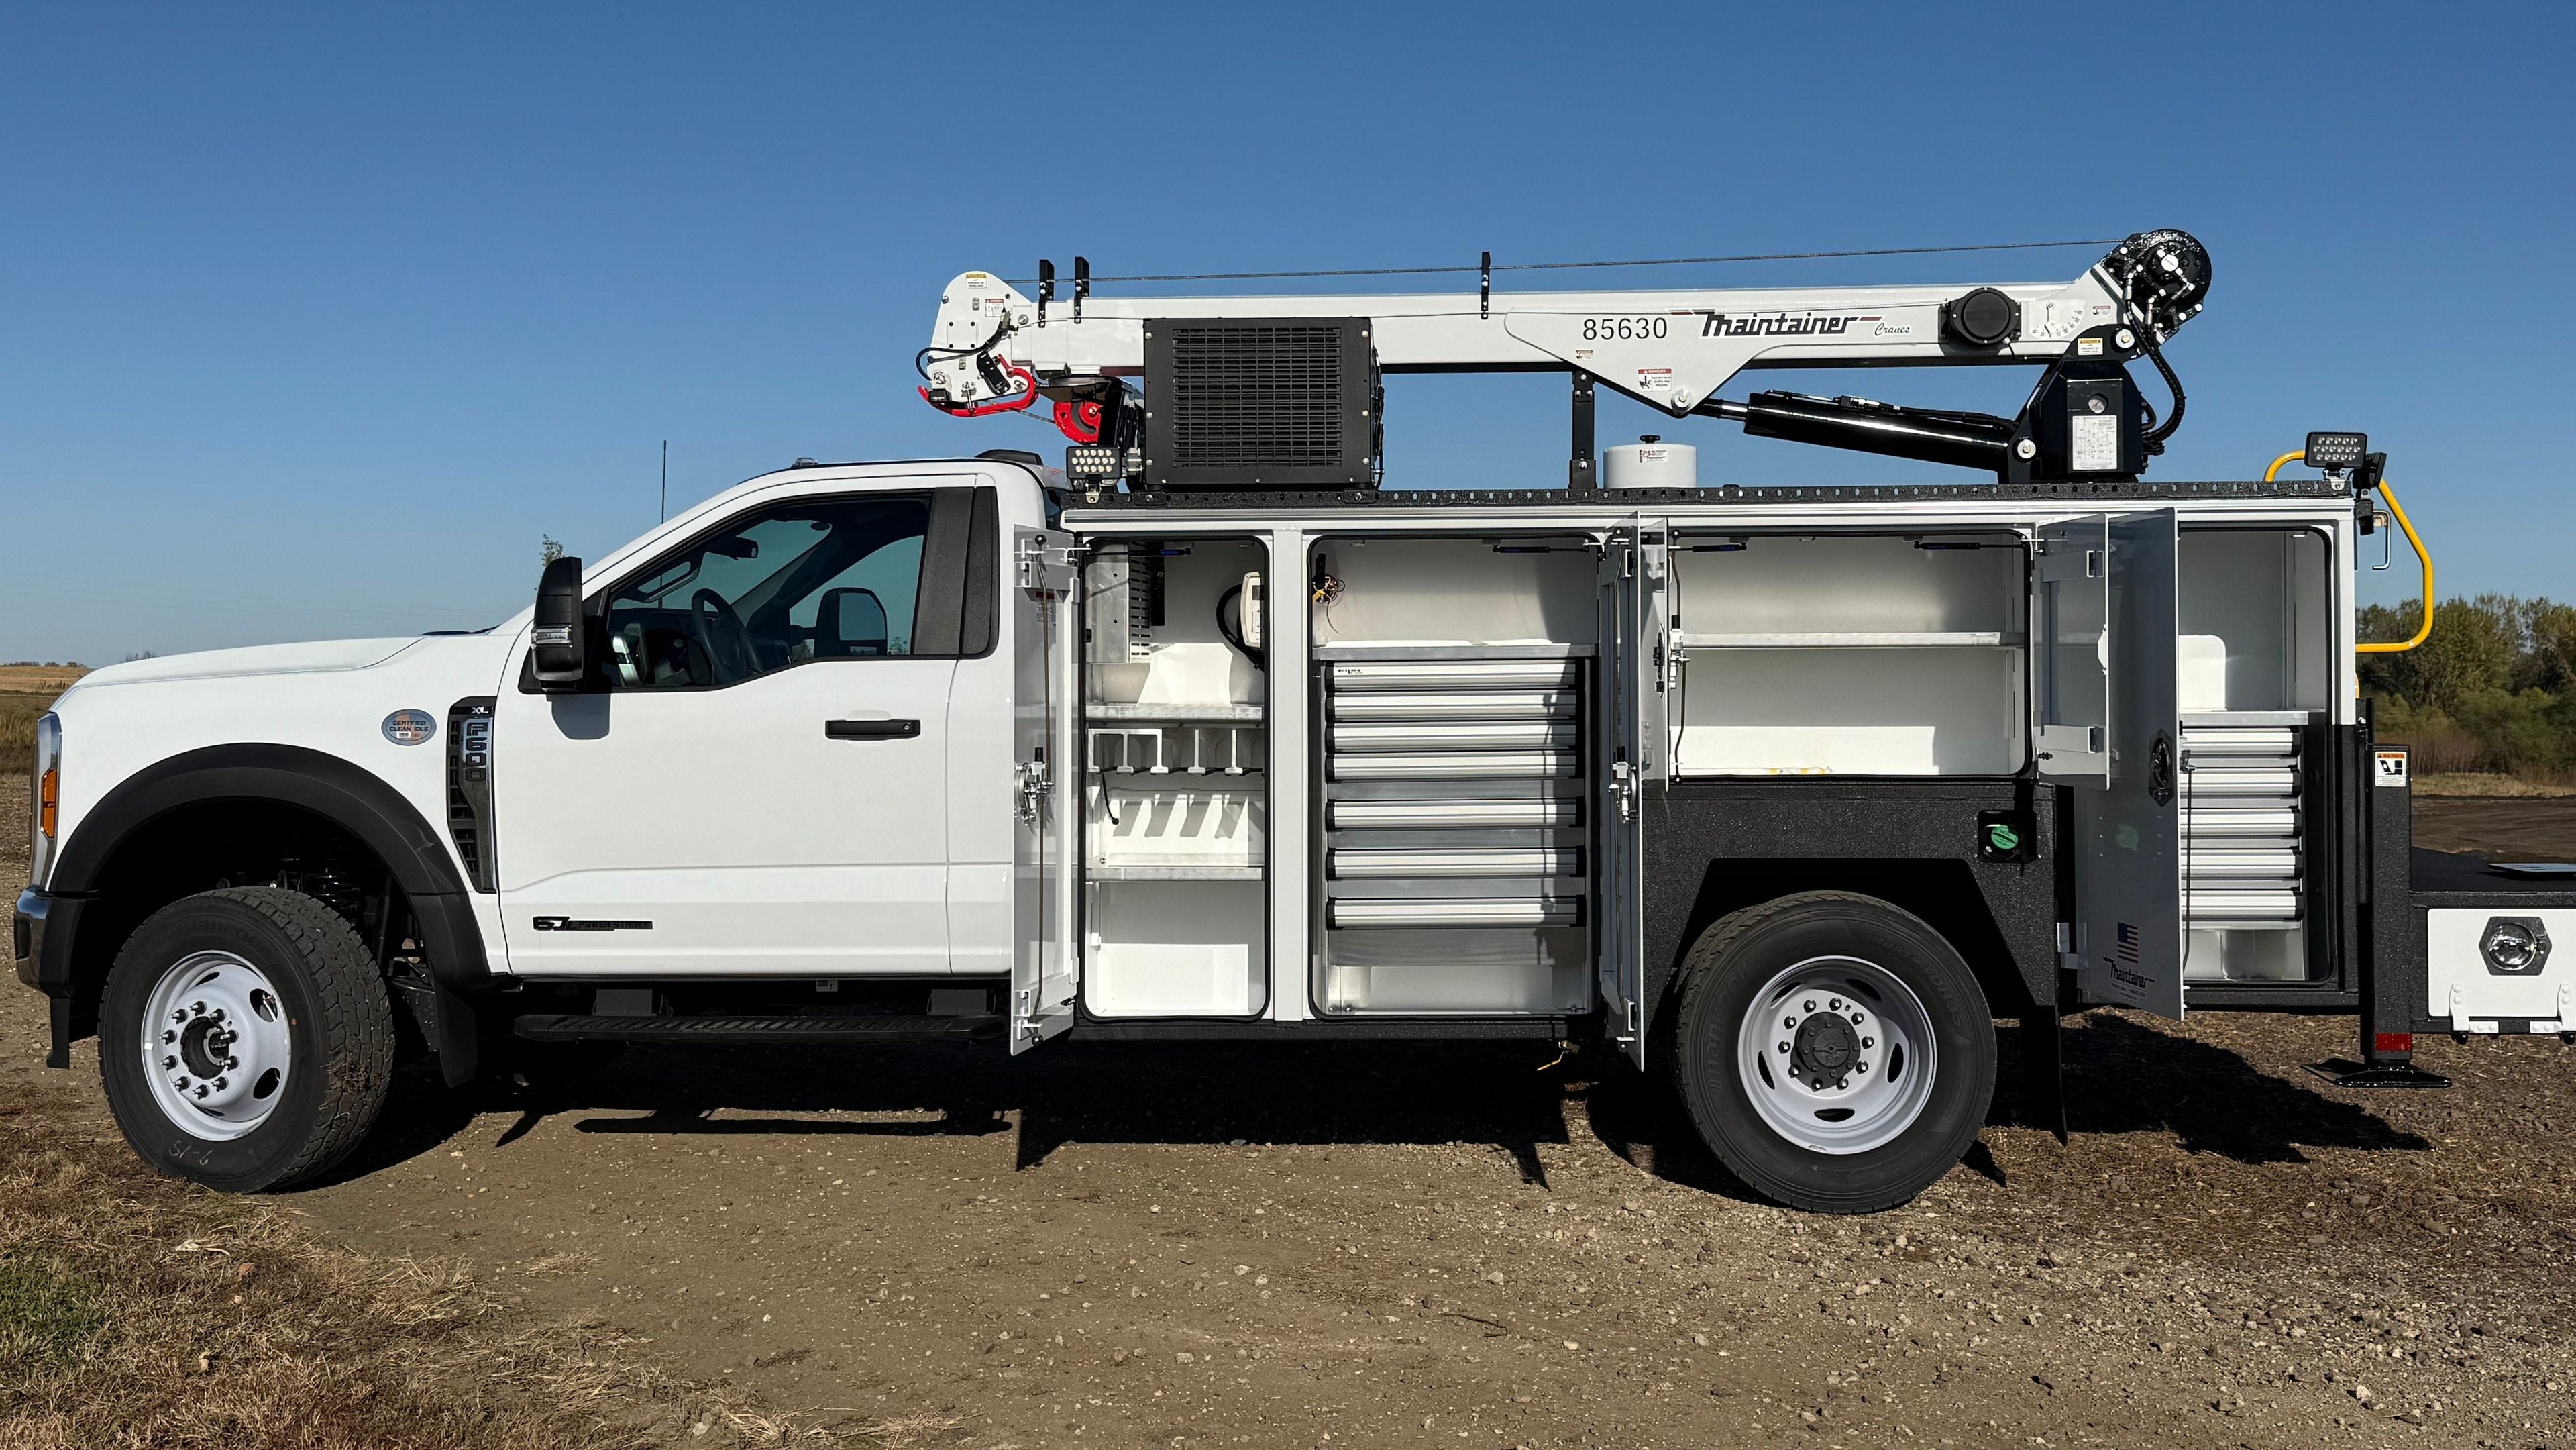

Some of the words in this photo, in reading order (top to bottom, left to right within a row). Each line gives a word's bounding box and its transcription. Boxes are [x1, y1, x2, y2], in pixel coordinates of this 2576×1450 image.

[1582, 317, 1668, 340] 85630
[1693, 311, 1858, 337] Maintainer
[1874, 322, 1911, 336] Cranes
[471, 706, 489, 715] XL
